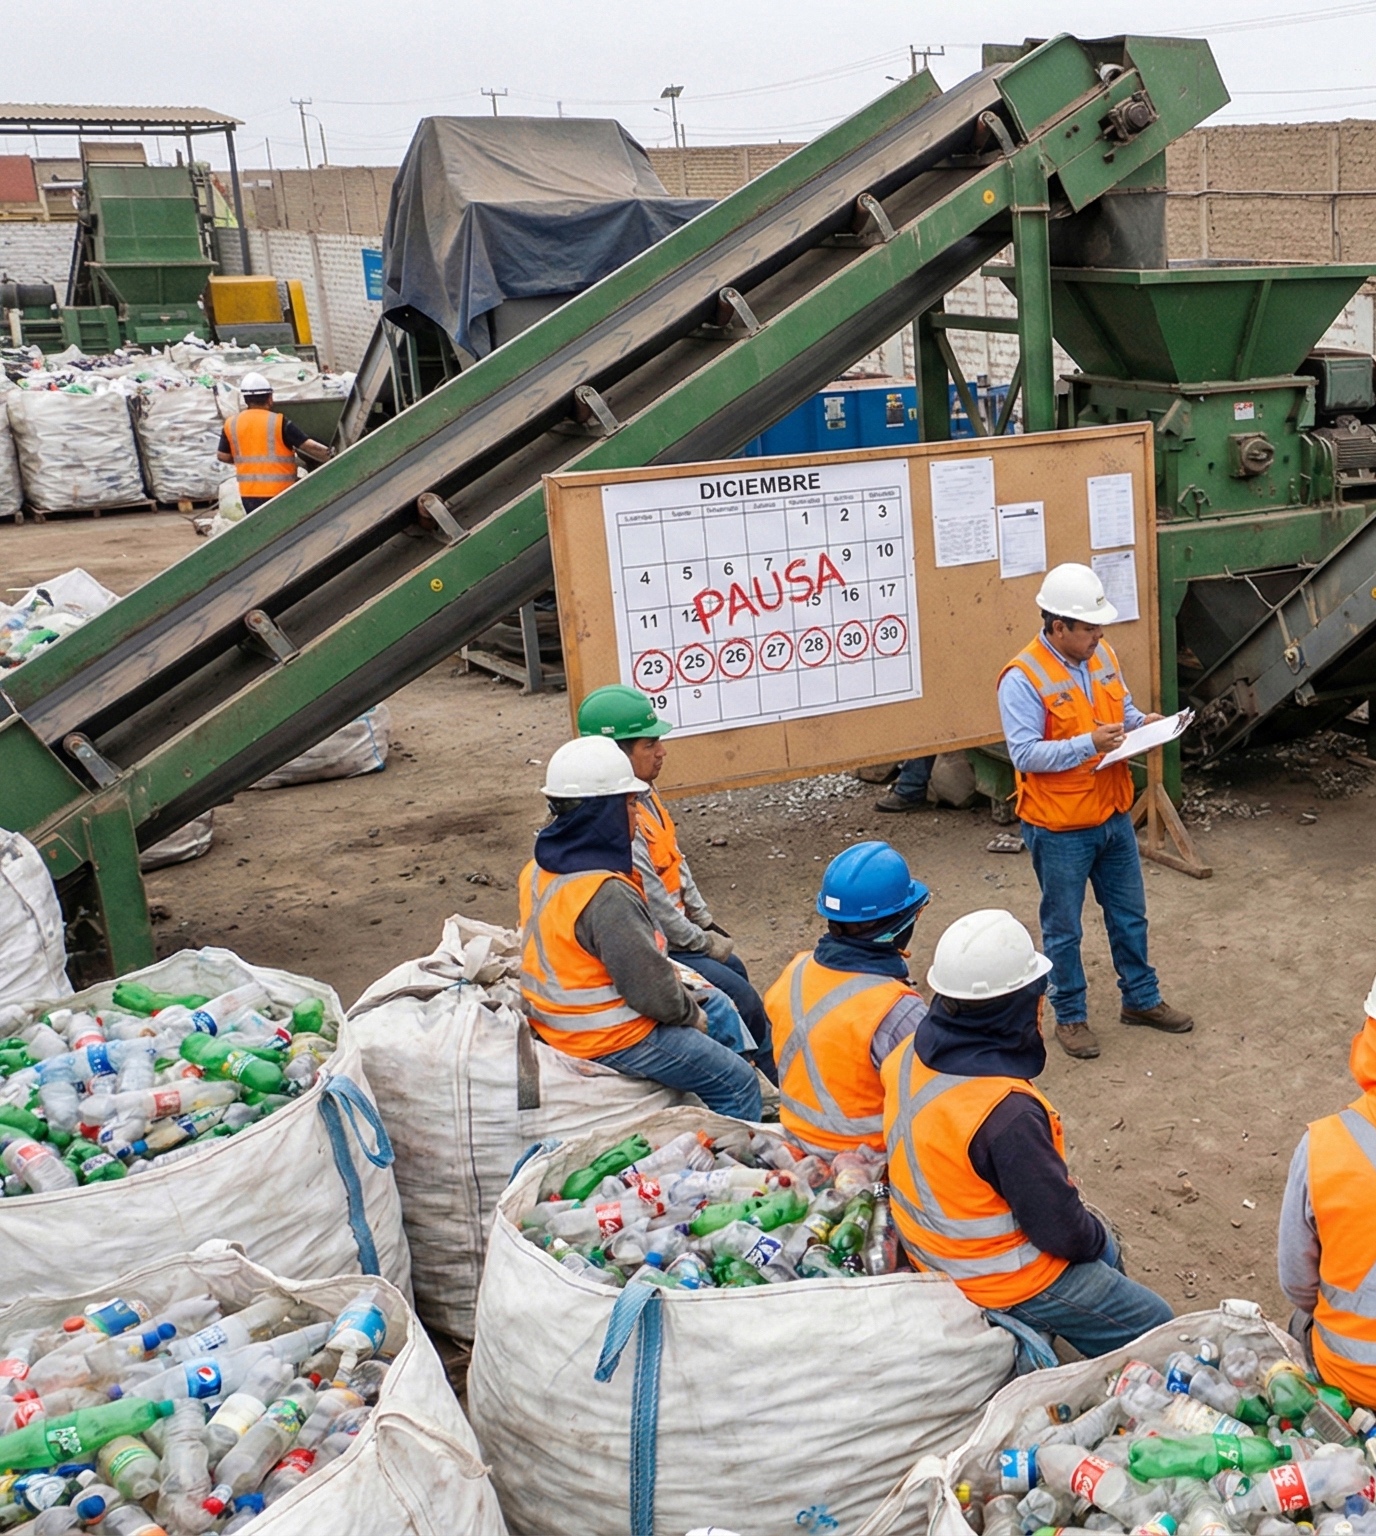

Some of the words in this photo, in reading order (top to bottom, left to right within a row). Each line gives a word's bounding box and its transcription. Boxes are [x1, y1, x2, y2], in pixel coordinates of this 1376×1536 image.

[700, 472, 821, 499] DICIEMBRE
[801, 511, 809, 525] 1
[840, 508, 849, 522] 2
[878, 504, 888, 518] 3
[639, 571, 651, 585] 4
[682, 566, 693, 580] 5
[723, 562, 734, 576] 6
[764, 557, 773, 571] 7
[842, 548, 852, 562] 9
[876, 543, 894, 558] 10
[640, 614, 658, 628] 11
[682, 608, 701, 622] 12
[841, 587, 860, 602] 16
[879, 583, 896, 597] 17
[693, 552, 846, 634] PAUSA
[643, 660, 663, 675] 23
[684, 653, 705, 670] 25
[725, 648, 746, 663] 26
[766, 642, 786, 658] 27
[804, 637, 824, 652] 28
[843, 631, 862, 647] 30
[880, 625, 898, 640] 30
